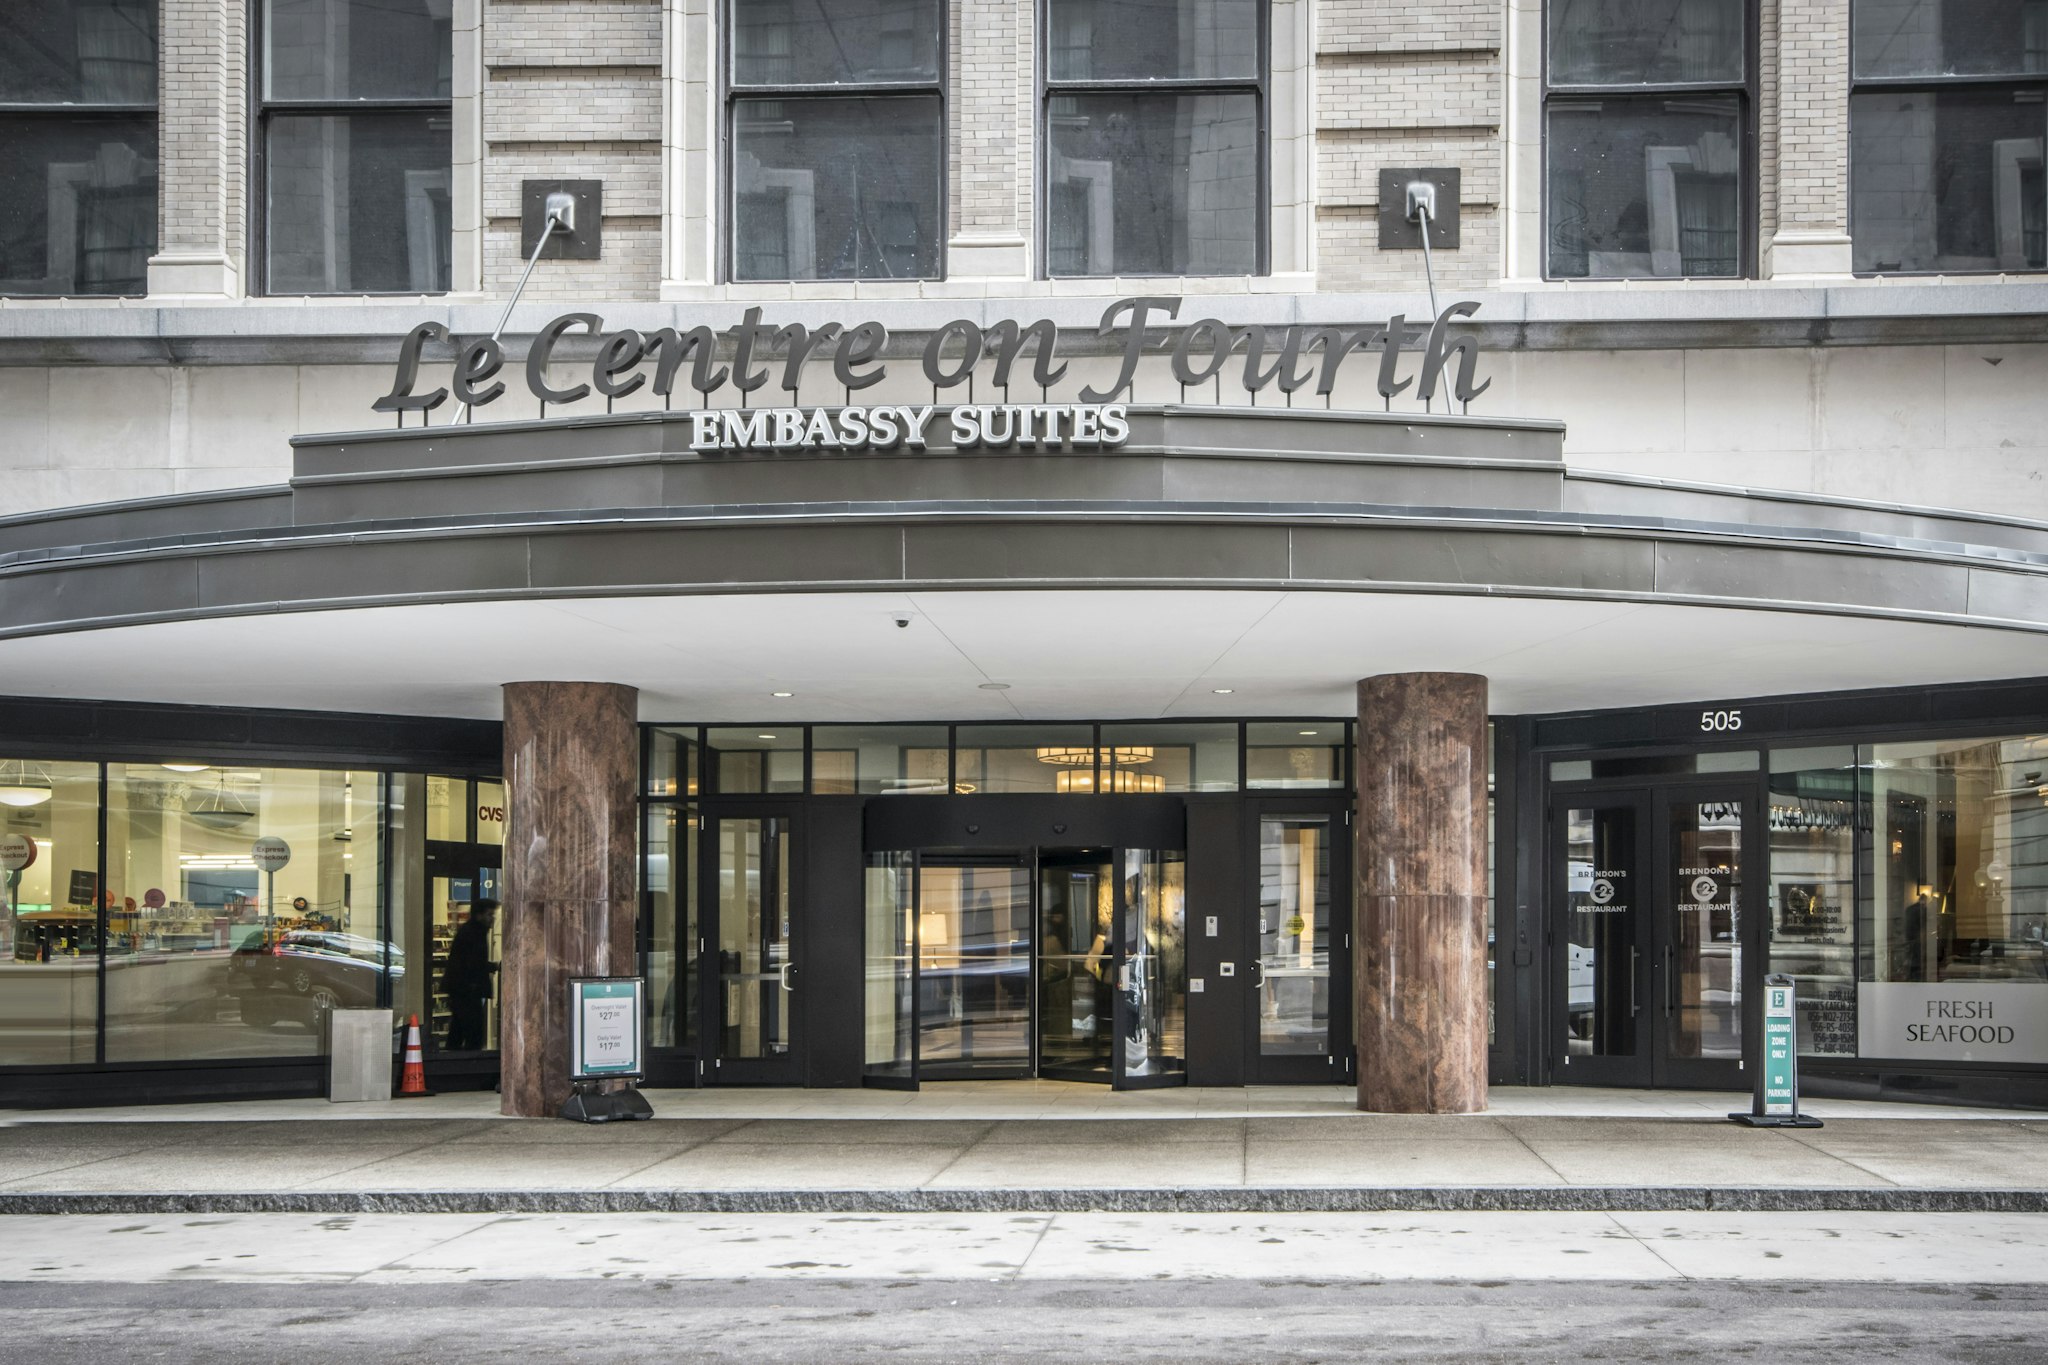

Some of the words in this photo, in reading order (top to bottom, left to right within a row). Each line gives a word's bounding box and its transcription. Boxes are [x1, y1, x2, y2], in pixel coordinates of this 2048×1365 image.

[372, 320, 506, 412] Le
[526, 306, 888, 405] Centre
[922, 317, 1068, 388] on
[1078, 297, 1491, 403] Fourth
[689, 406, 934, 453] EMBASSY
[951, 405, 1129, 448] SUITES
[1701, 710, 1742, 731] 505
[479, 805, 503, 822] CVS
[1578, 870, 1627, 878] BRENDON'S
[1679, 867, 1730, 876] BRENDON'S
[1577, 905, 1628, 913] RESTAURANT
[1678, 903, 1731, 912] RESTAURANT
[1926, 1000, 1993, 1019] FRESH
[1767, 1023, 1790, 1032] LOADING
[1906, 1024, 2015, 1044] SEAFOOD
[1771, 1037, 1786, 1045] ZONE
[1771, 1050, 1786, 1058] ONLY
[1774, 1076, 1783, 1085] NO
[1767, 1089, 1790, 1097] PARKING
